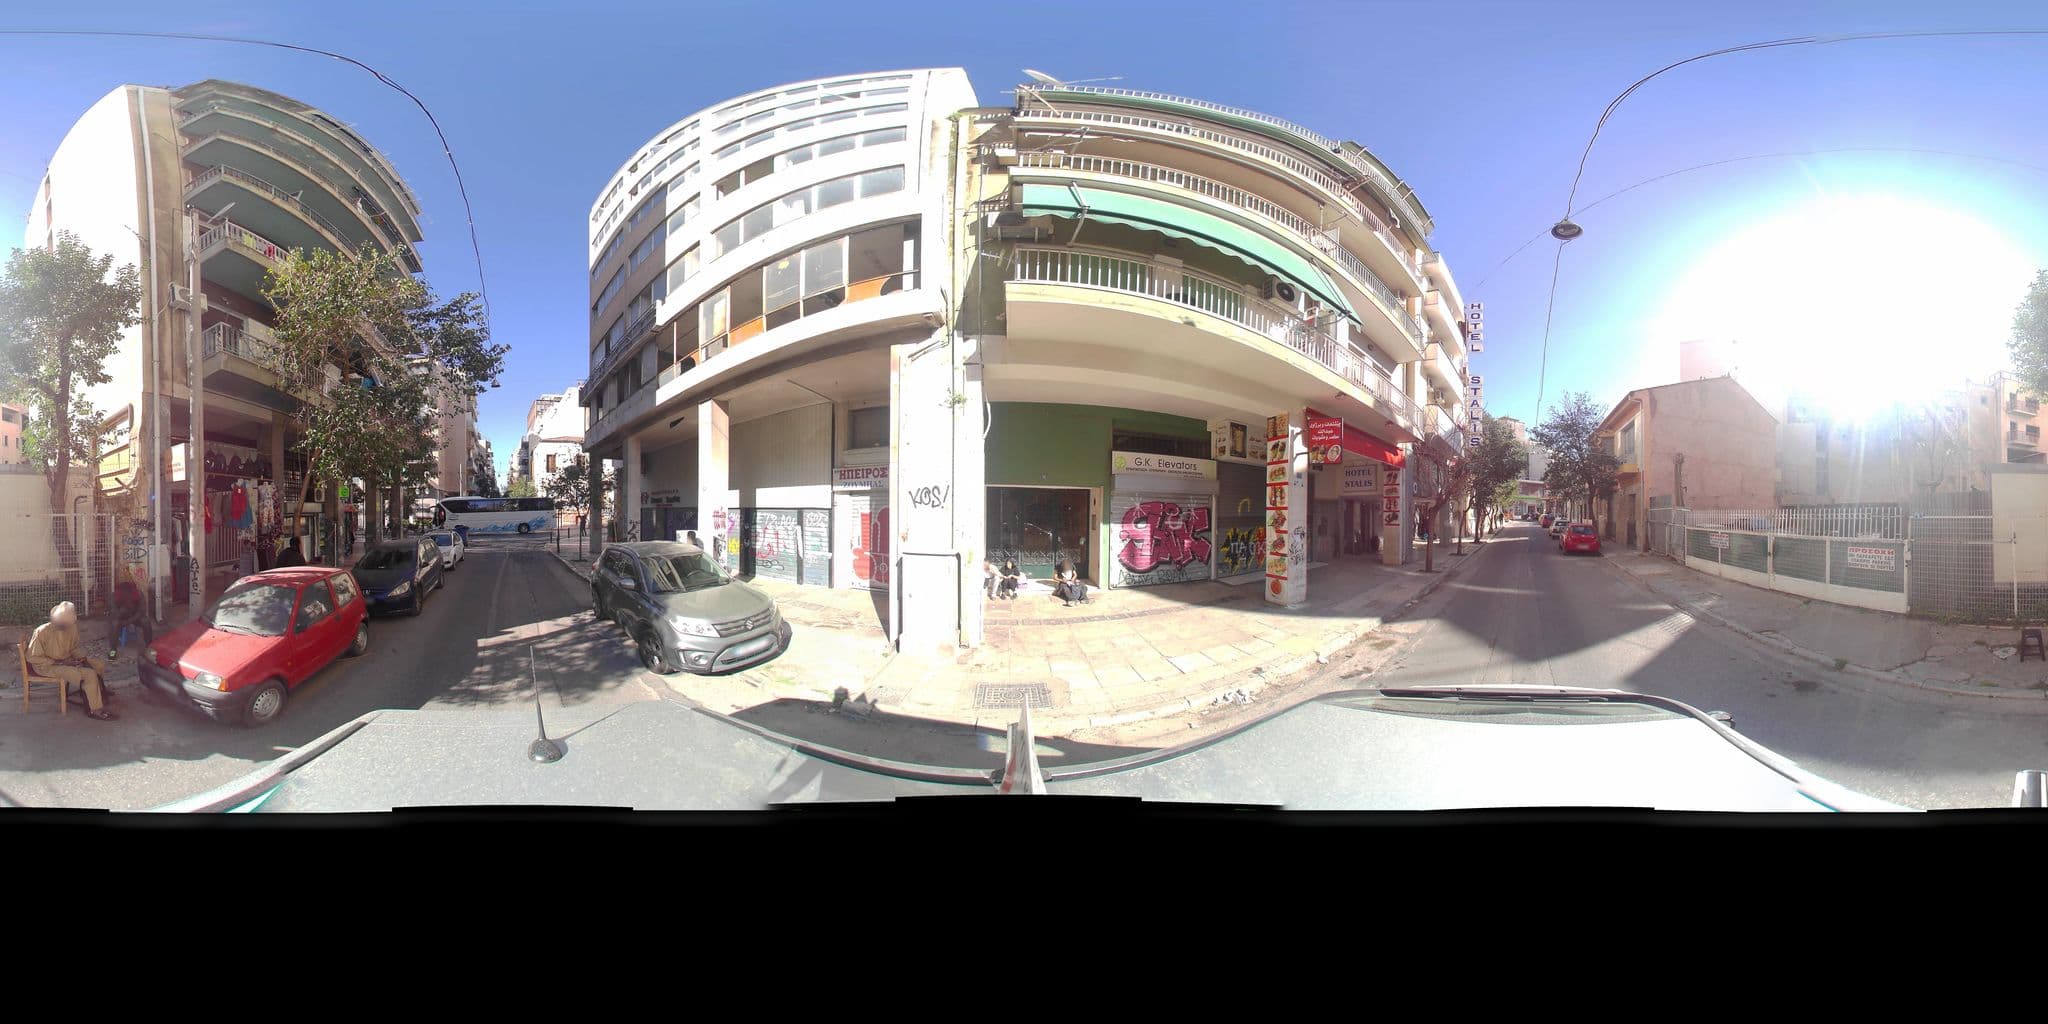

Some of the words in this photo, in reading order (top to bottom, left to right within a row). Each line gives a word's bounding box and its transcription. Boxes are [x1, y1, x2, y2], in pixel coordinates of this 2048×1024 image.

[1470, 303, 1481, 352] HOTEL
[1470, 376, 1481, 446] STALIS
[1134, 457, 1152, 467] G.K.
[1158, 459, 1197, 470] Elevators
[1345, 469, 1372, 477] HOTEL
[1344, 480, 1373, 488] STALIS
[1849, 547, 1894, 555] ΠΡΟΣΟΧΗ
